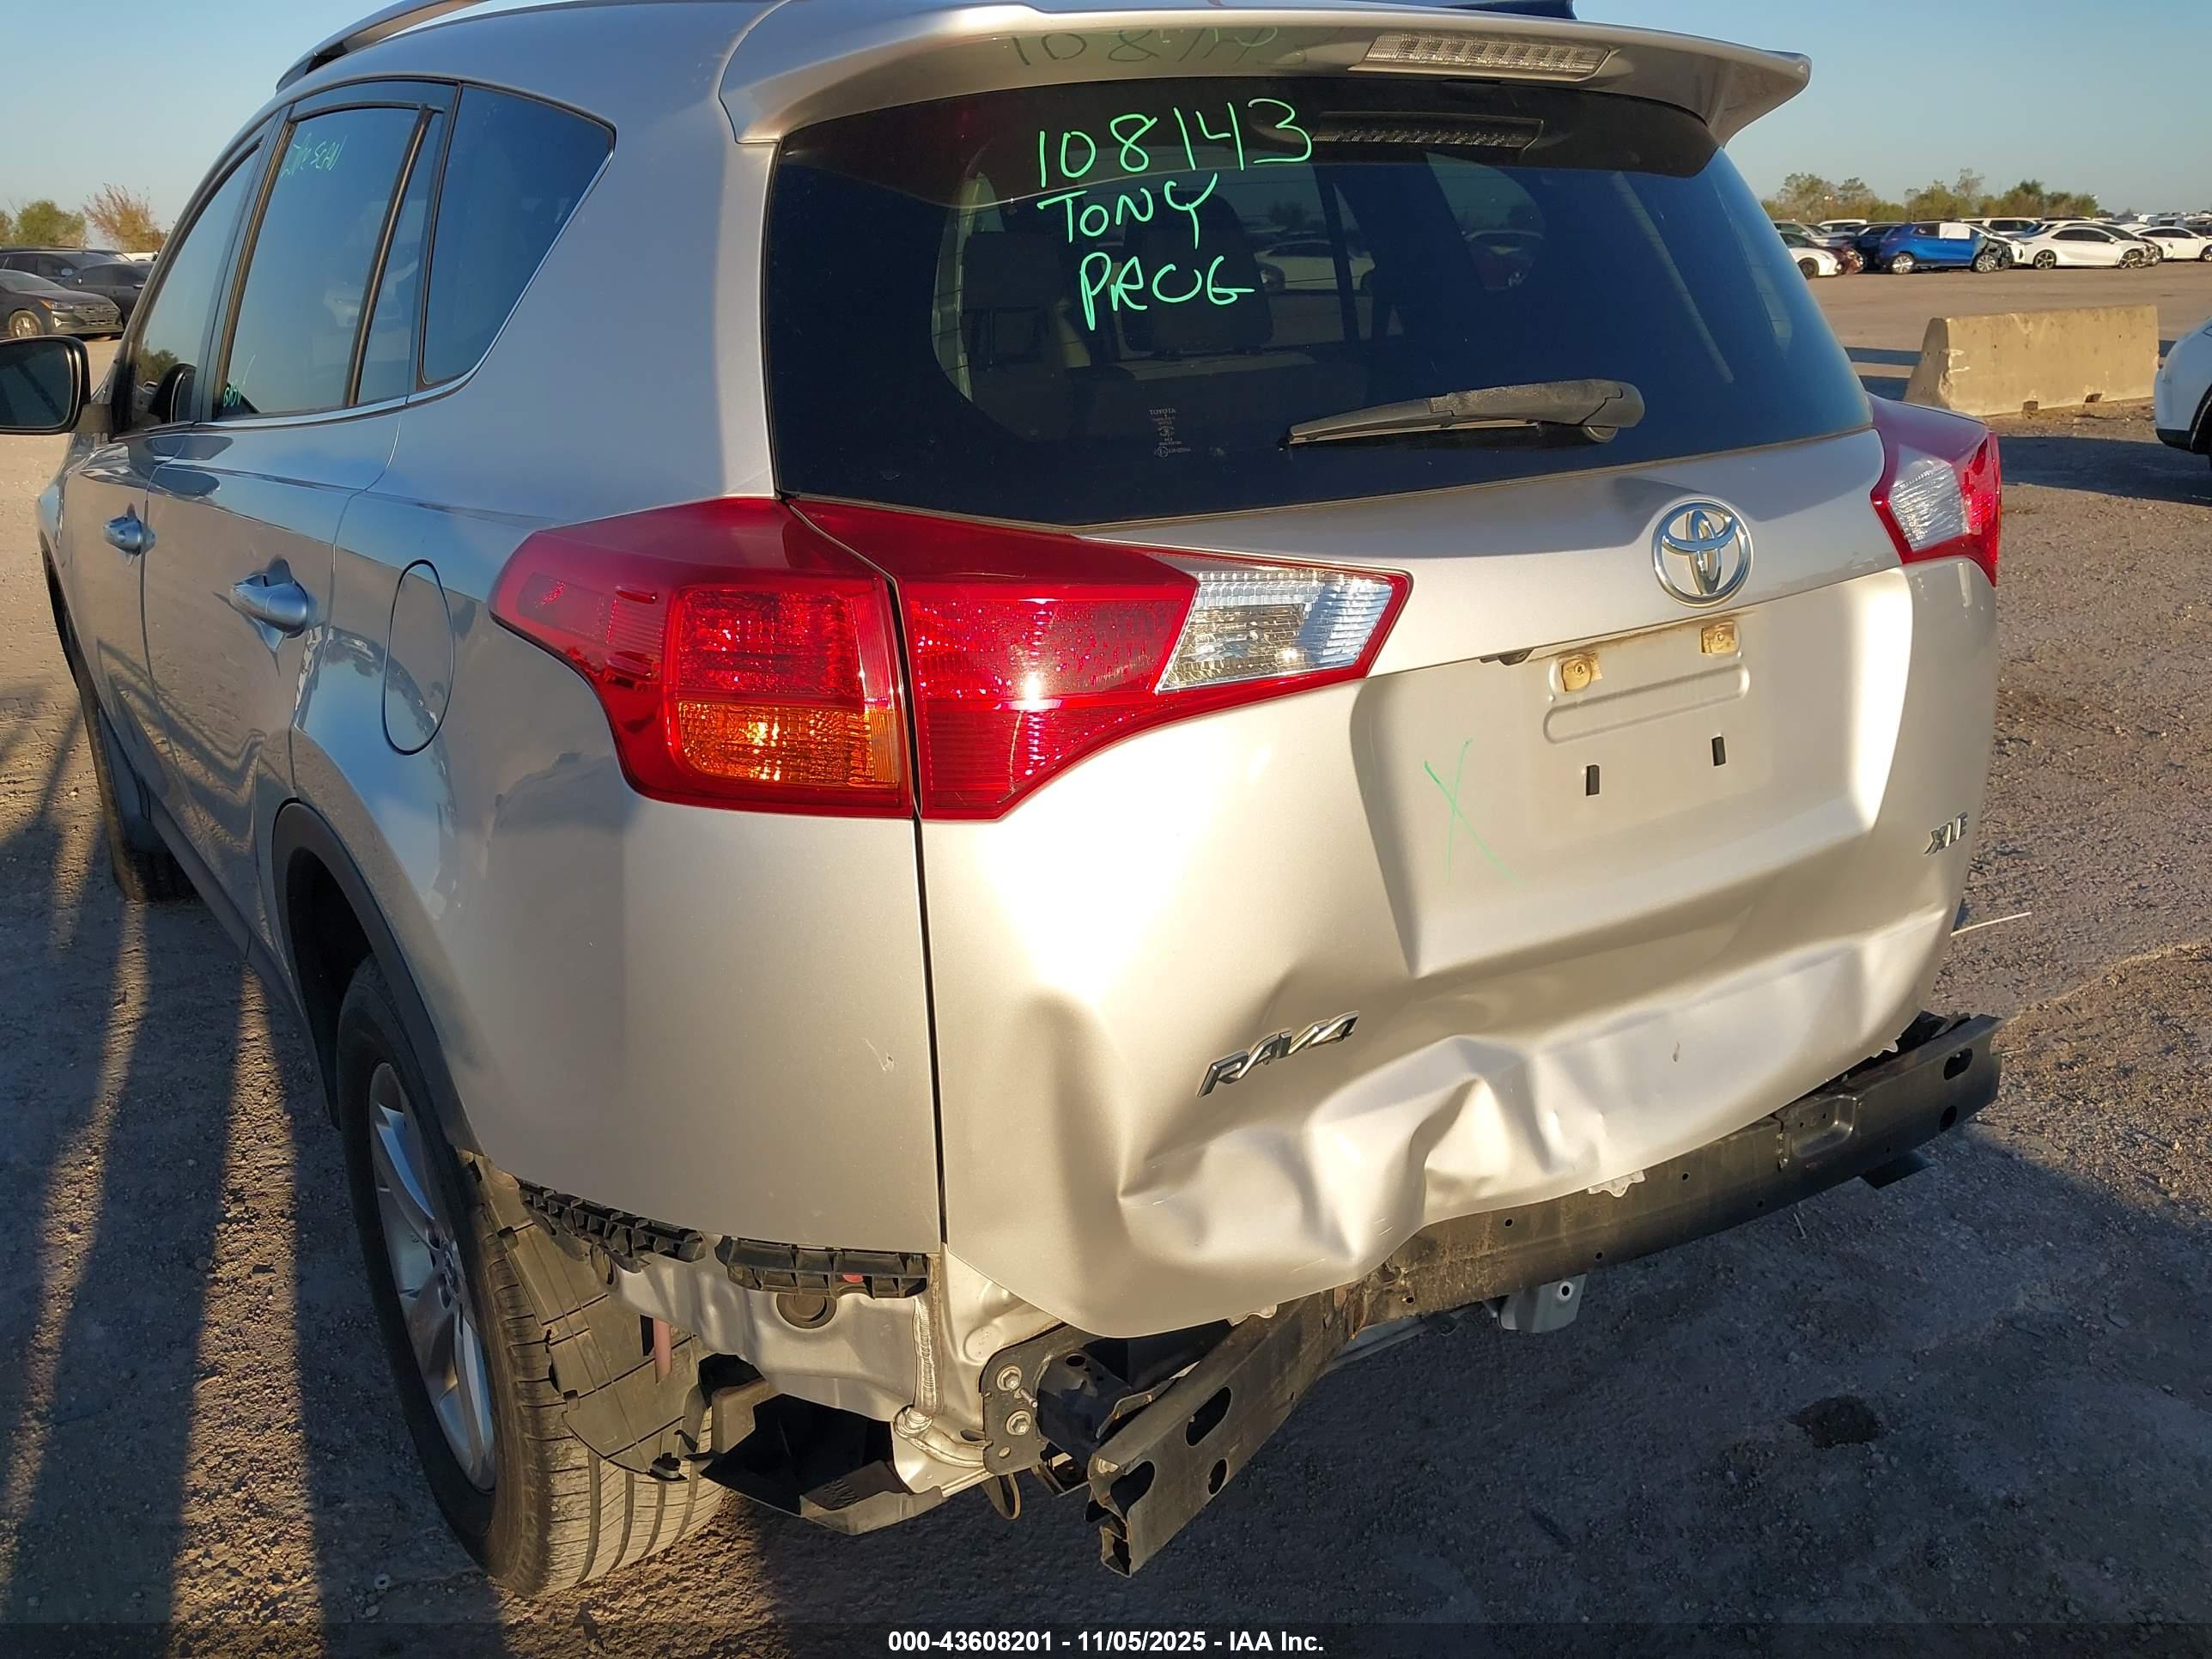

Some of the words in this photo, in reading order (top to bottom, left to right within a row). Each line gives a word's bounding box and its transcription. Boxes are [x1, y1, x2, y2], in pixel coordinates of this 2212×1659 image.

[1039, 98, 1312, 188] 108143
[1036, 172, 1218, 249] TONY
[1196, 1010, 1360, 1099] RAV4
